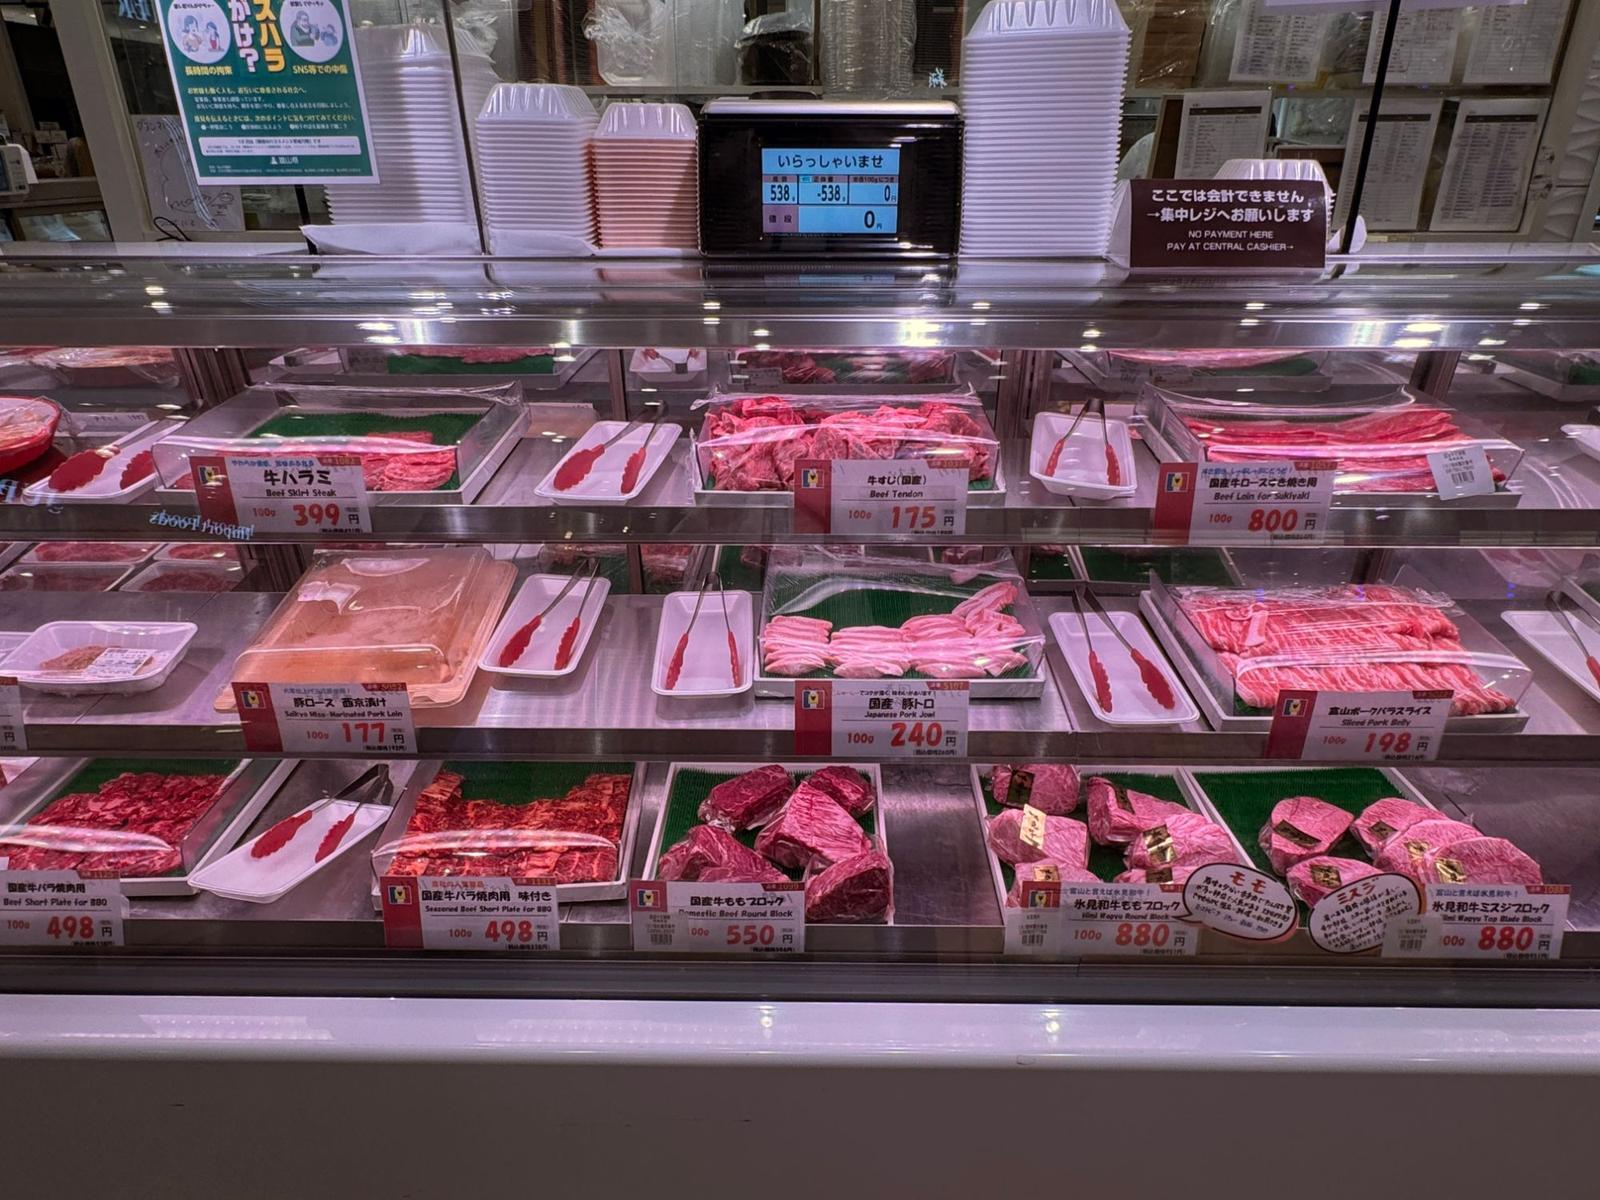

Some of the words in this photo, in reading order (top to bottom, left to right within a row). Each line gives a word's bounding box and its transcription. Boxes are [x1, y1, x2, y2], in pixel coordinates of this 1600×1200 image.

[778, 155, 883, 168] いらっしゃいませ
[770, 184, 790, 201] 538
[817, 184, 841, 201] -538
[884, 186, 890, 200] 0
[864, 210, 875, 228] 0
[1160, 207, 1314, 222] 集中レジへお願いします
[264, 470, 331, 486] 牛ハラミ
[1209, 478, 1317, 488] 国産牛ロースすき焼き用
[870, 490, 889, 498] Beef
[893, 490, 923, 498] Tendon
[1214, 492, 1233, 500] Beef
[1236, 492, 1255, 500] Loin
[1257, 492, 1271, 500] for
[1274, 492, 1310, 500] Sukiyaki
[293, 503, 340, 526] 399
[349, 514, 359, 524] 円
[892, 506, 936, 529] 175
[944, 517, 954, 526] 円
[1248, 509, 1298, 533] 800
[1305, 519, 1316, 530] 円
[294, 698, 335, 708] 豚ロース
[342, 698, 387, 708] 西京漬け
[869, 698, 893, 710] 国産
[902, 698, 934, 710] 豚トロ
[1328, 707, 1432, 716] 富山ポークバラスライス
[342, 723, 385, 743] 177
[394, 734, 404, 744] 円
[890, 722, 942, 748] 240
[945, 736, 956, 747] 円
[1364, 732, 1412, 753] 198
[1417, 742, 1428, 751] 円
[7, 883, 86, 893] 国産牛バラ焼肉用
[1337, 877, 1379, 904] ミスジ
[3, 898, 21, 906] Beef
[25, 898, 48, 906] Short
[51, 898, 72, 906] Plate
[74, 898, 88, 906] for
[90, 898, 107, 906] BBQ
[422, 891, 511, 901] 国産牛バラ焼肉用
[518, 891, 552, 901] 味付き
[690, 896, 784, 906] 国産牛ももブロック
[1074, 900, 1180, 911] 氷見和牛ももブロック
[1432, 902, 1550, 913] 氷見和牛ミスジブロック
[1125, 912, 1148, 920] Round
[1484, 915, 1497, 923] Top
[47, 916, 94, 939] 498
[102, 927, 112, 937] 円
[484, 920, 533, 942] 498
[537, 931, 548, 942] 円
[726, 925, 775, 945] 550
[782, 934, 793, 944] 円
[1115, 923, 1170, 947] 880
[1174, 937, 1185, 947] 円
[1478, 926, 1534, 950] 880
[1538, 940, 1550, 950] 円
